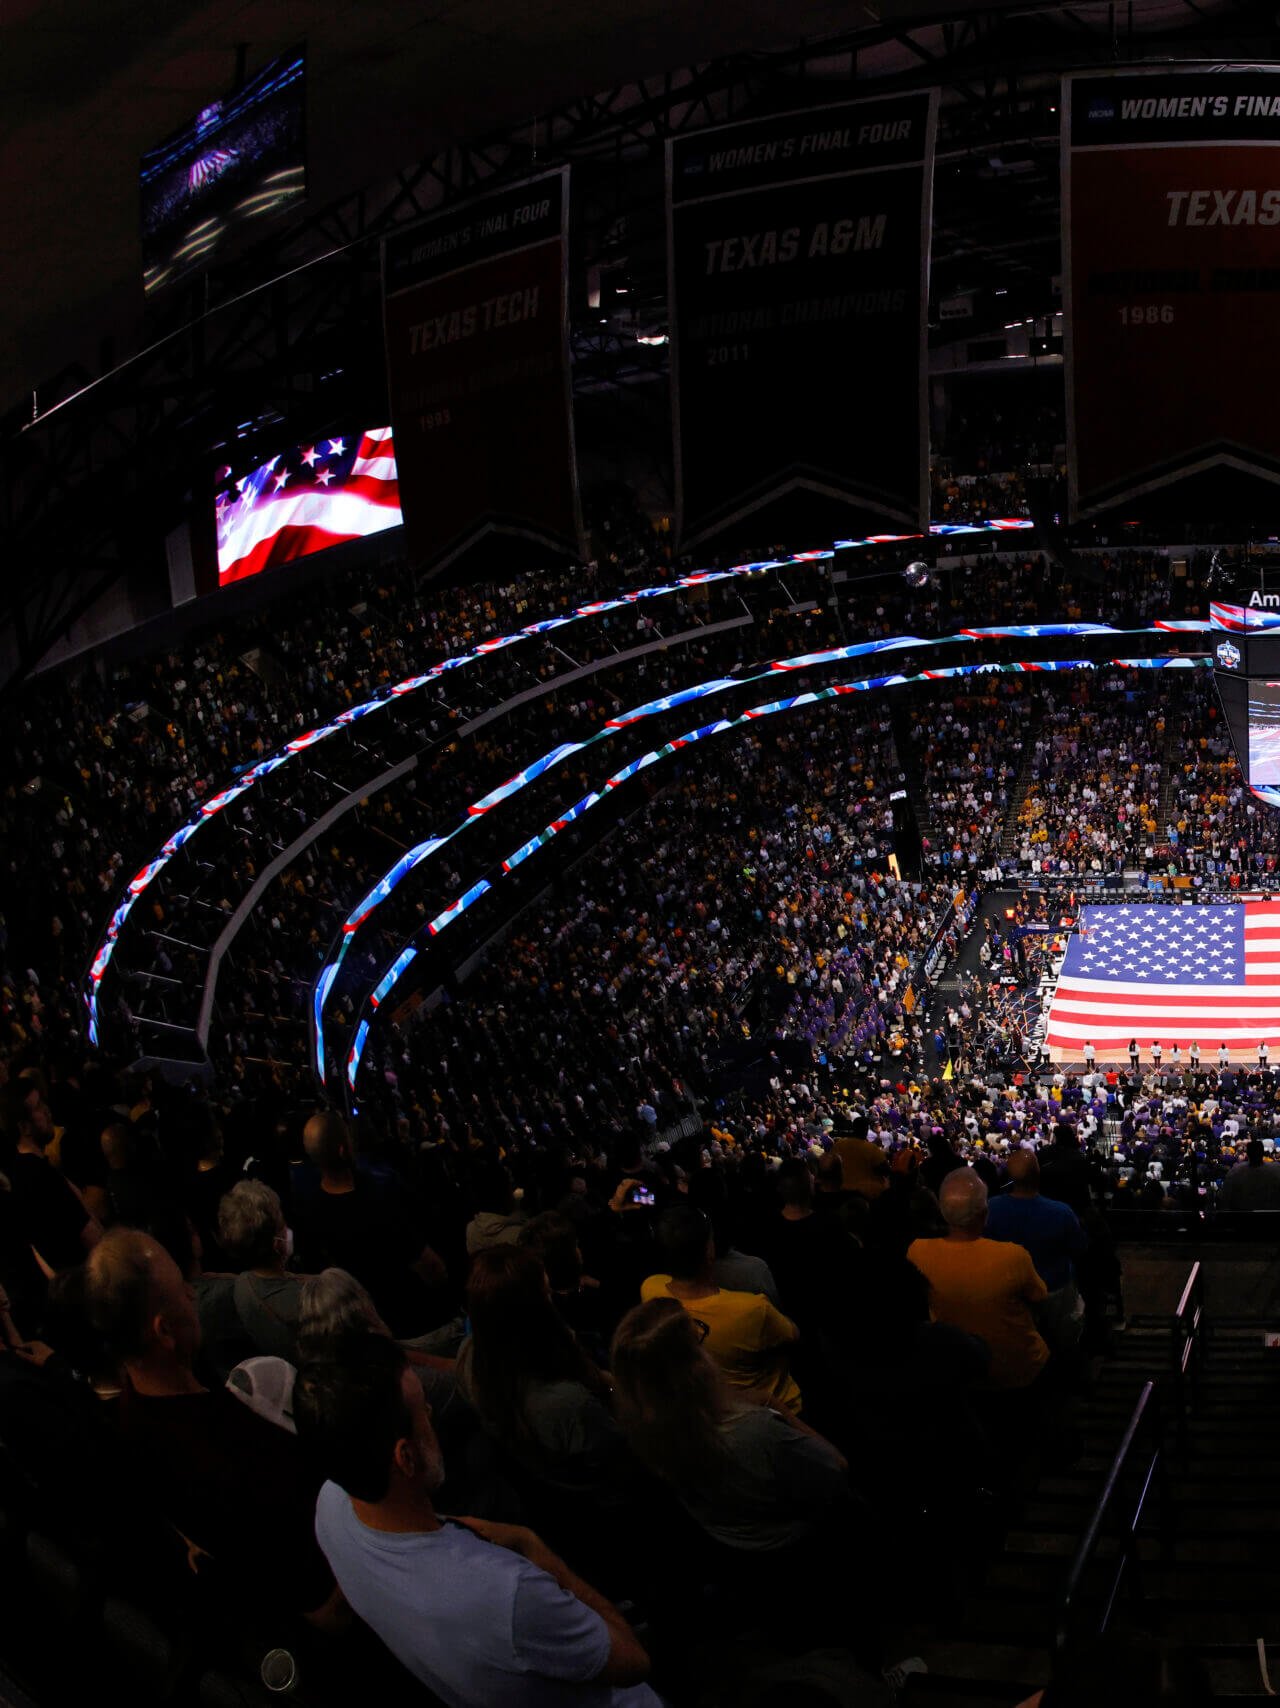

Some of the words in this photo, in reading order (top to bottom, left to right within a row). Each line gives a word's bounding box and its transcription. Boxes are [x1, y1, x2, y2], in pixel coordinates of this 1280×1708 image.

[1120, 96, 1229, 120] WOMEN'S
[707, 136, 796, 174] WOMEN'S
[799, 129, 850, 158] FINAL
[857, 120, 912, 145] FOUR
[512, 200, 551, 232] FOUR
[704, 226, 801, 276] TEXAS
[807, 212, 888, 258] A&M
[408, 304, 478, 357] TEXAS
[482, 287, 541, 332] TECH
[1118, 304, 1177, 327] 1986
[704, 343, 751, 368] 2011
